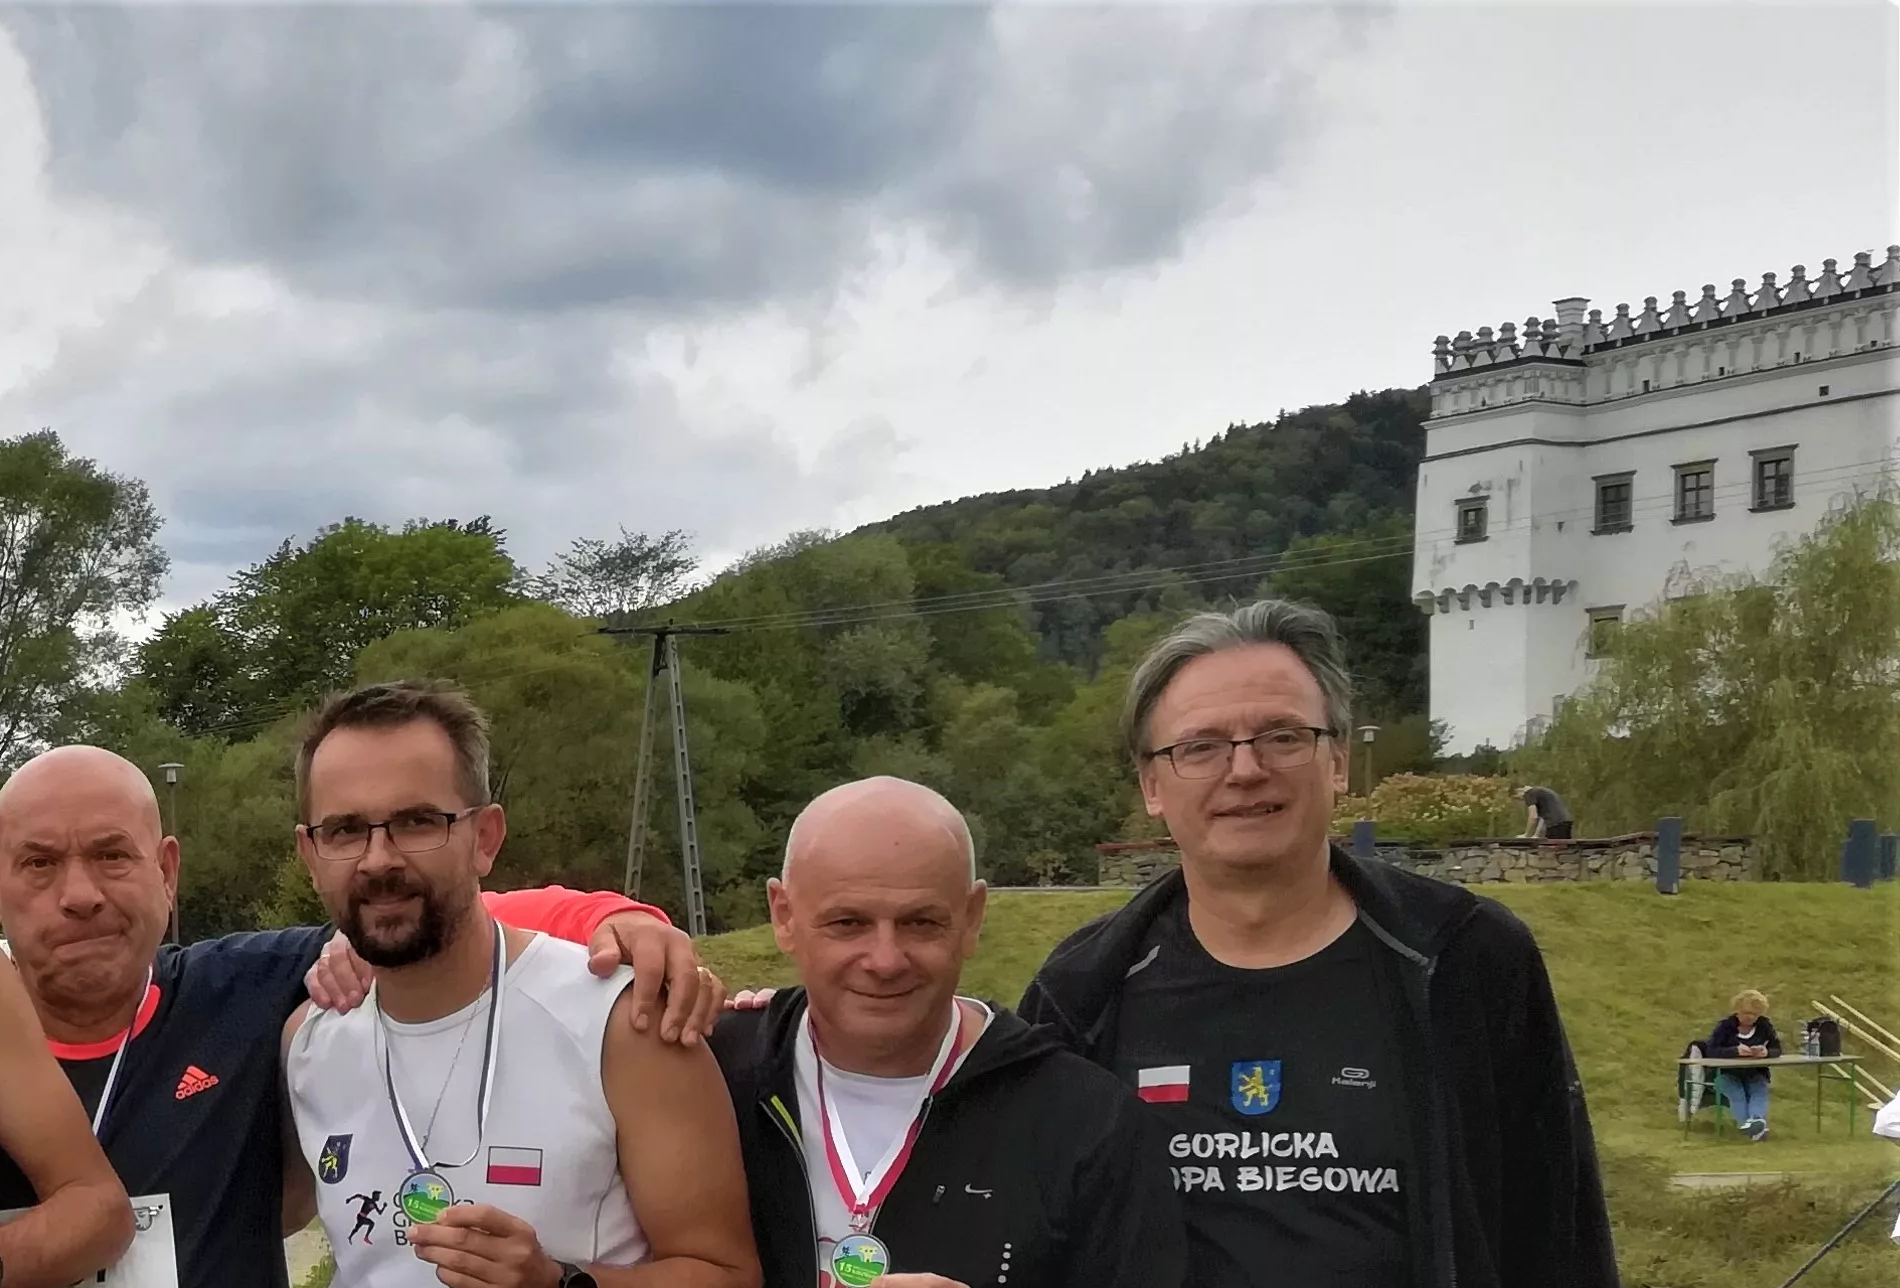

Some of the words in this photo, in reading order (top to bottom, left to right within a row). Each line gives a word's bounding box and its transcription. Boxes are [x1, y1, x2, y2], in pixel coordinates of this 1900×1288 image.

[175, 1075, 219, 1100] adidas
[1168, 1131, 1339, 1159] GORLICKA
[1237, 1166, 1400, 1193] BIEGOWA
[840, 1262, 853, 1273] 15
